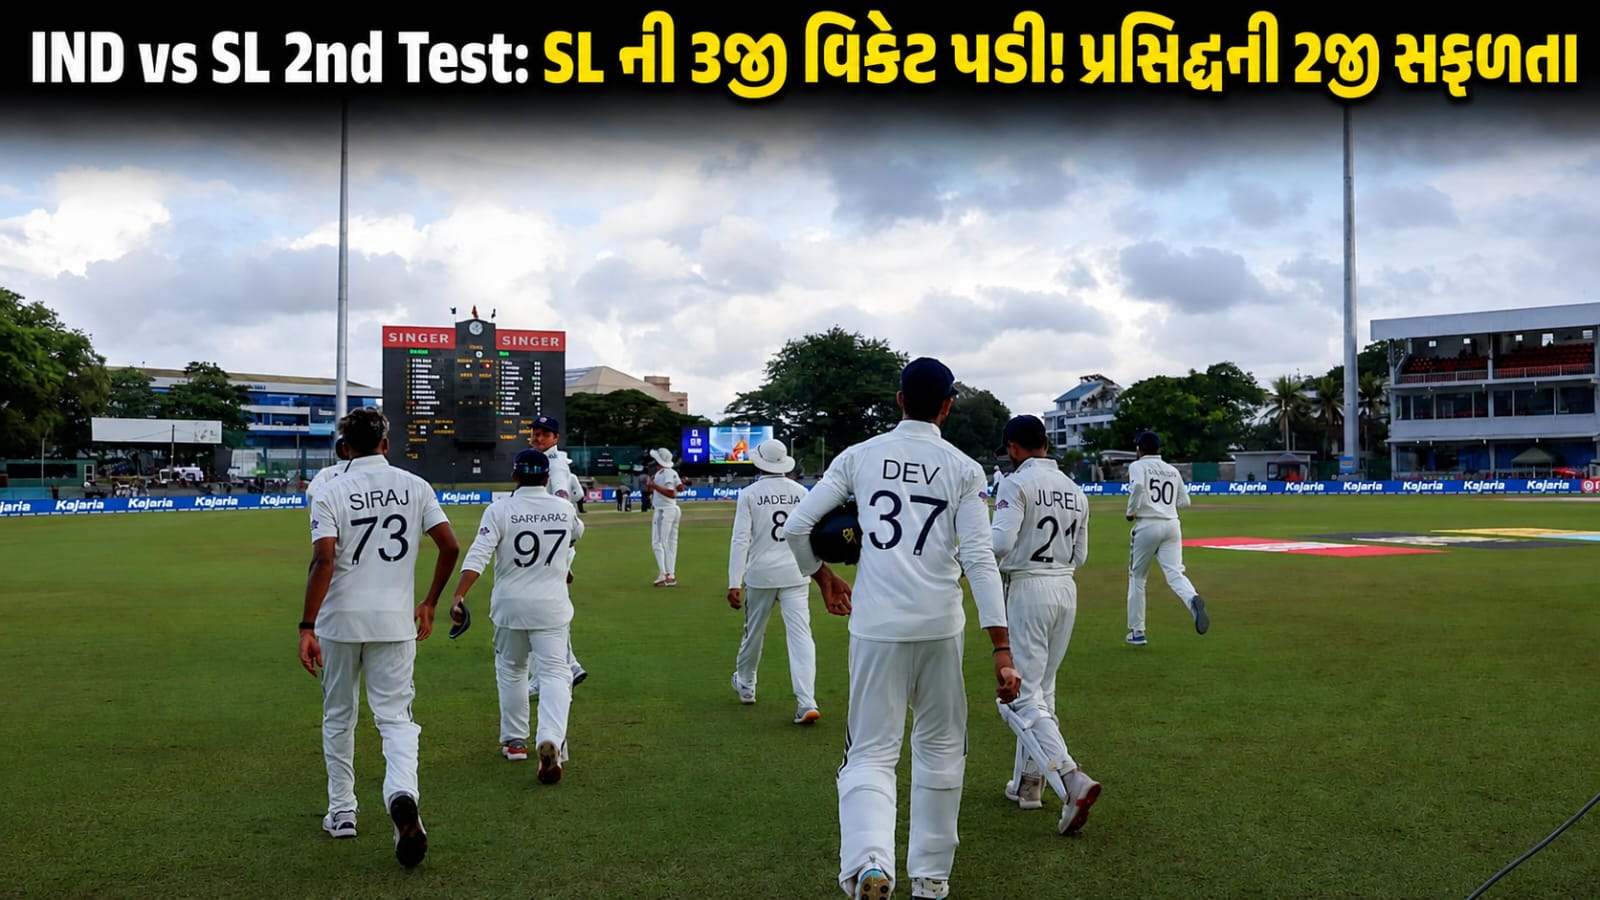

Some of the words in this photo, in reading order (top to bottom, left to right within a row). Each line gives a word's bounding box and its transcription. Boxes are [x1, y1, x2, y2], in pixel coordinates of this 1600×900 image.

[388, 332, 449, 344] SINGER
[502, 335, 560, 347] SINGER
[883, 459, 941, 485] DEV
[1149, 478, 1174, 505] 50
[1229, 482, 1267, 494] Kajaria
[1285, 481, 1324, 493] Kajaria
[1343, 481, 1383, 491] Kajaria
[1403, 481, 1443, 491] Kajaria
[1463, 480, 1505, 491] Kajaria
[1526, 480, 1570, 491] Kajaria
[349, 488, 409, 511] SIRAJ
[713, 488, 741, 499] Kajari
[55, 500, 104, 512] Kajaria
[128, 498, 174, 510] Kajaria
[195, 496, 238, 508] Kajaria
[260, 494, 302, 506] Kajaria
[757, 494, 801, 506] JADEJA
[1035, 489, 1082, 513] JUREL
[0, 501, 31, 513] jaria
[770, 510, 789, 543] 8
[869, 489, 949, 556] 37
[350, 513, 409, 565] 73
[1030, 515, 1078, 565] 21
[513, 529, 567, 568] 97
